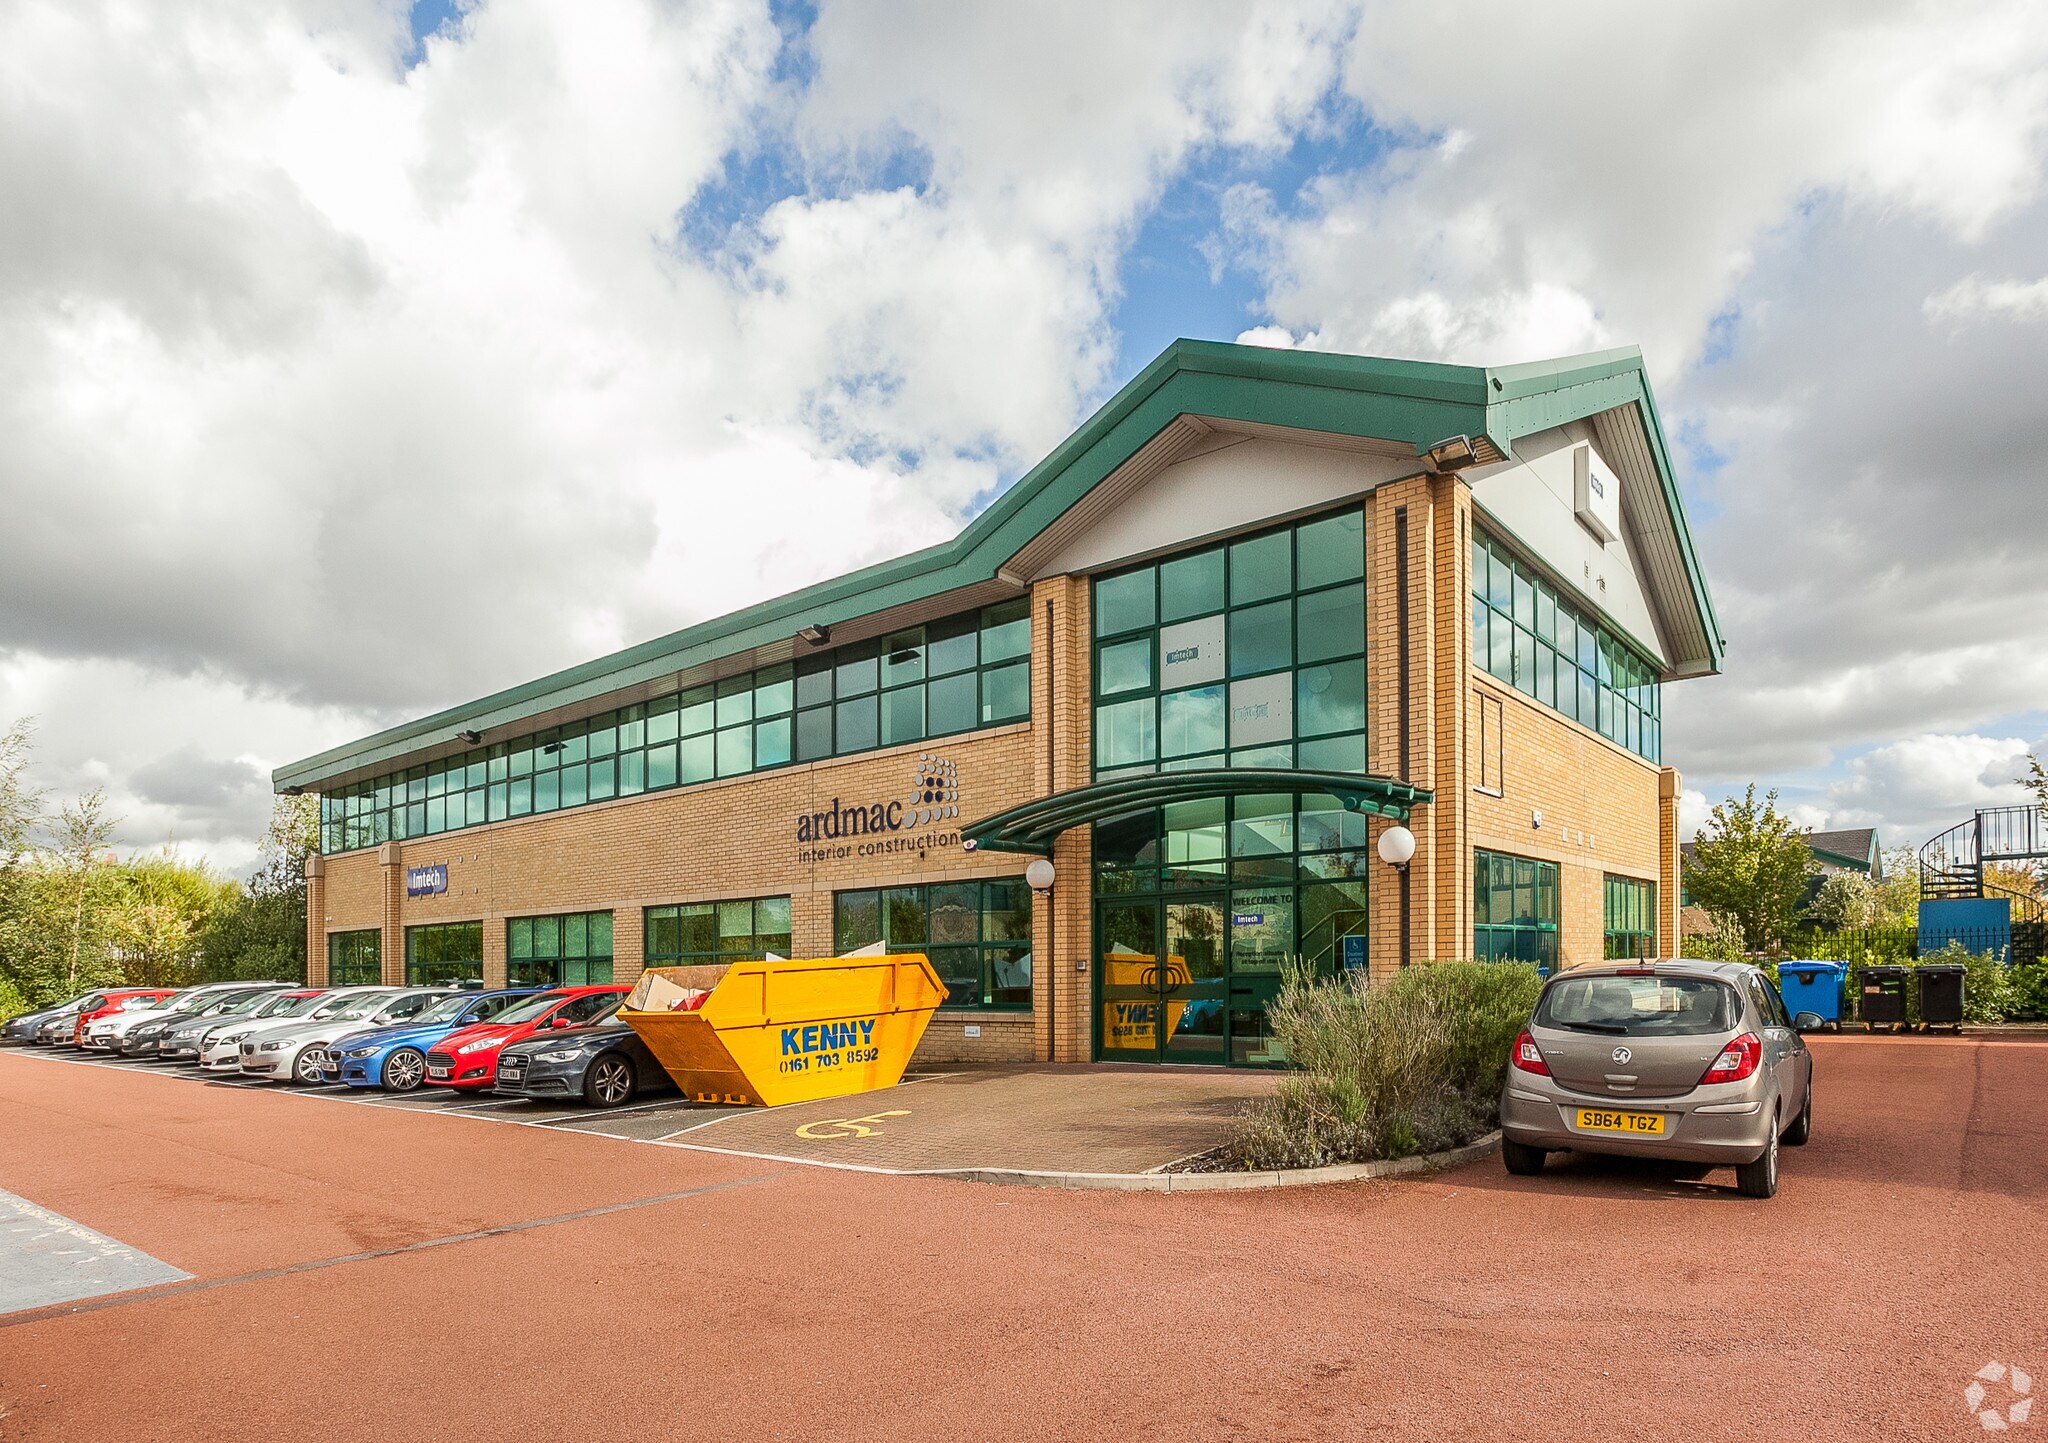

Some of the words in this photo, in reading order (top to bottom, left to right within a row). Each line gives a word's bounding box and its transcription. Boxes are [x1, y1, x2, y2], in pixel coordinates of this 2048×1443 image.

[797, 797, 902, 842] ardmac
[799, 844, 851, 863] interior
[857, 831, 959, 856] construction
[412, 869, 441, 889] Imtech
[1232, 895, 1279, 906] WELCOME
[1280, 894, 1293, 904] TO
[1237, 915, 1258, 923] Imtech
[781, 1019, 876, 1056] KENNY
[780, 1057, 808, 1073] 0161
[816, 1053, 840, 1068] 703
[847, 1047, 879, 1063] 8592
[1583, 1112, 1622, 1128] SB64
[1628, 1115, 1657, 1131] TGZ
